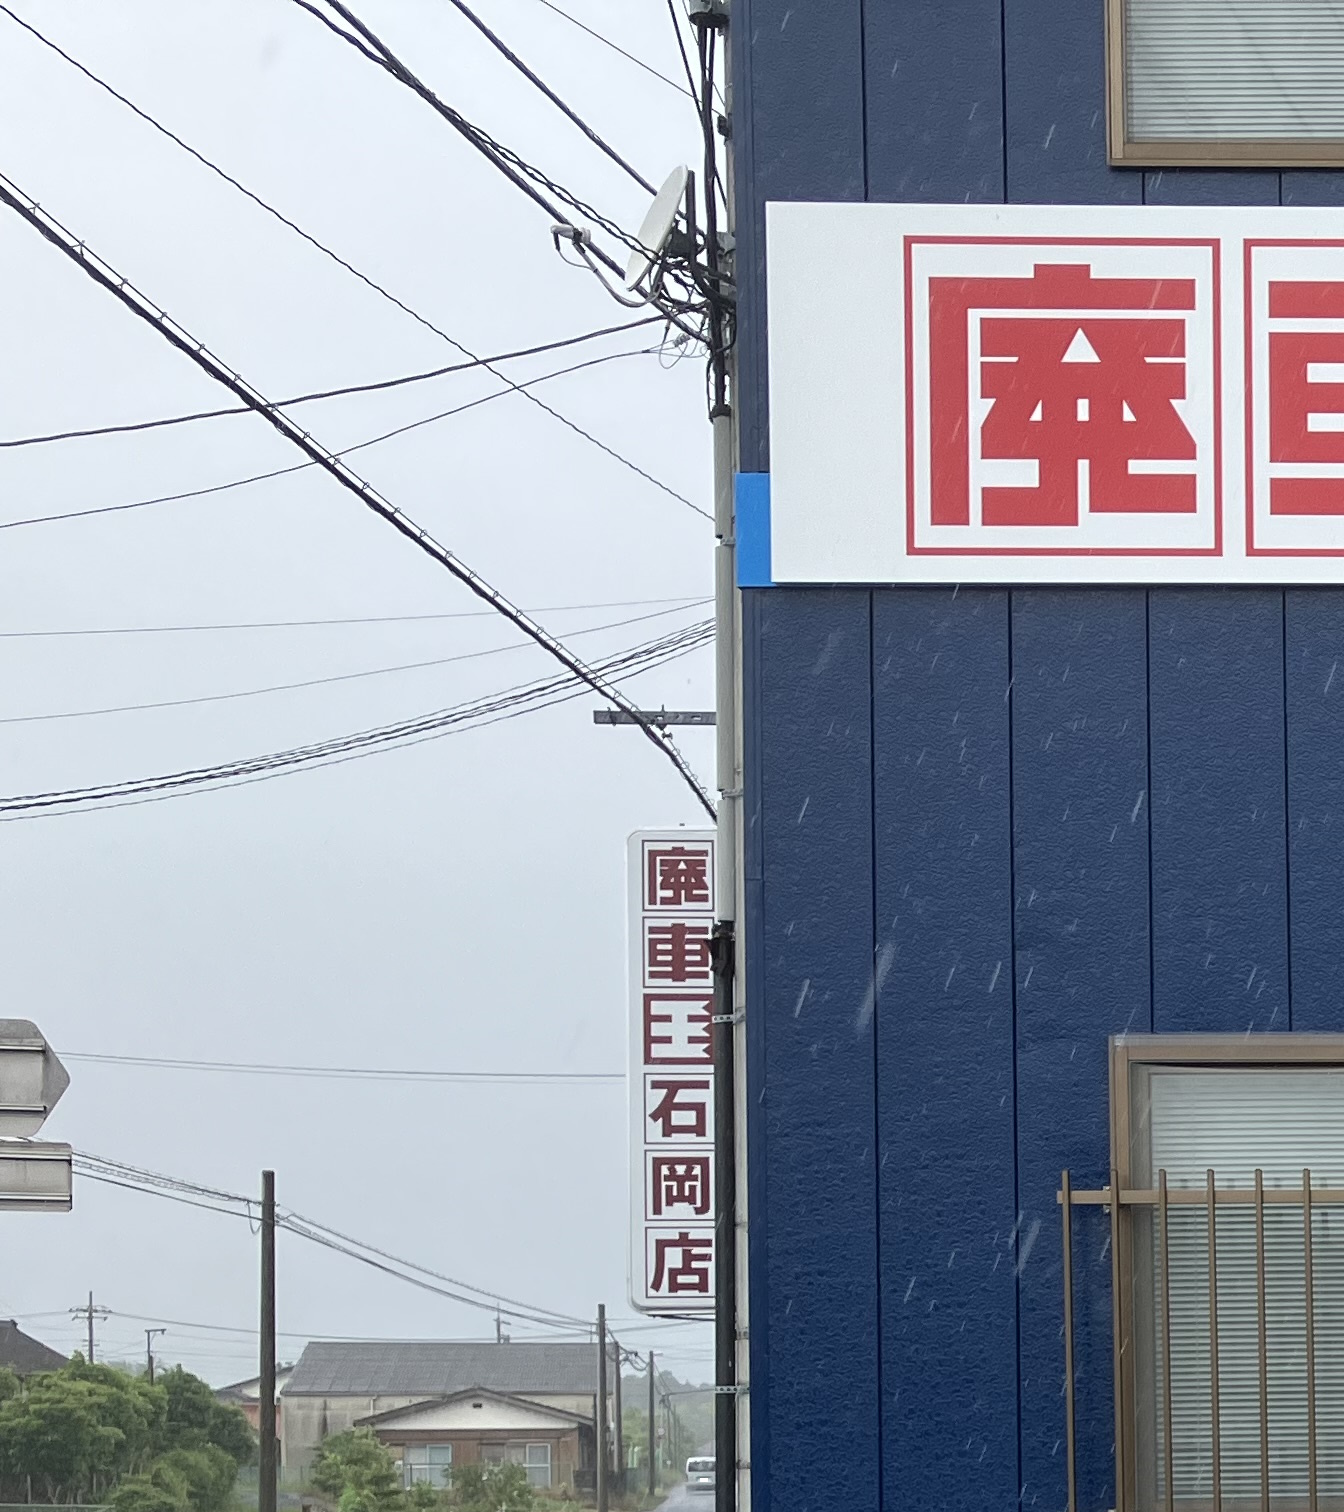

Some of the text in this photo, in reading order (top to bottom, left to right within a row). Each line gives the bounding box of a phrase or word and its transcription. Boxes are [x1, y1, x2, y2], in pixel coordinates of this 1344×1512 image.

[645, 846, 713, 1294] 廃車王石岡店
